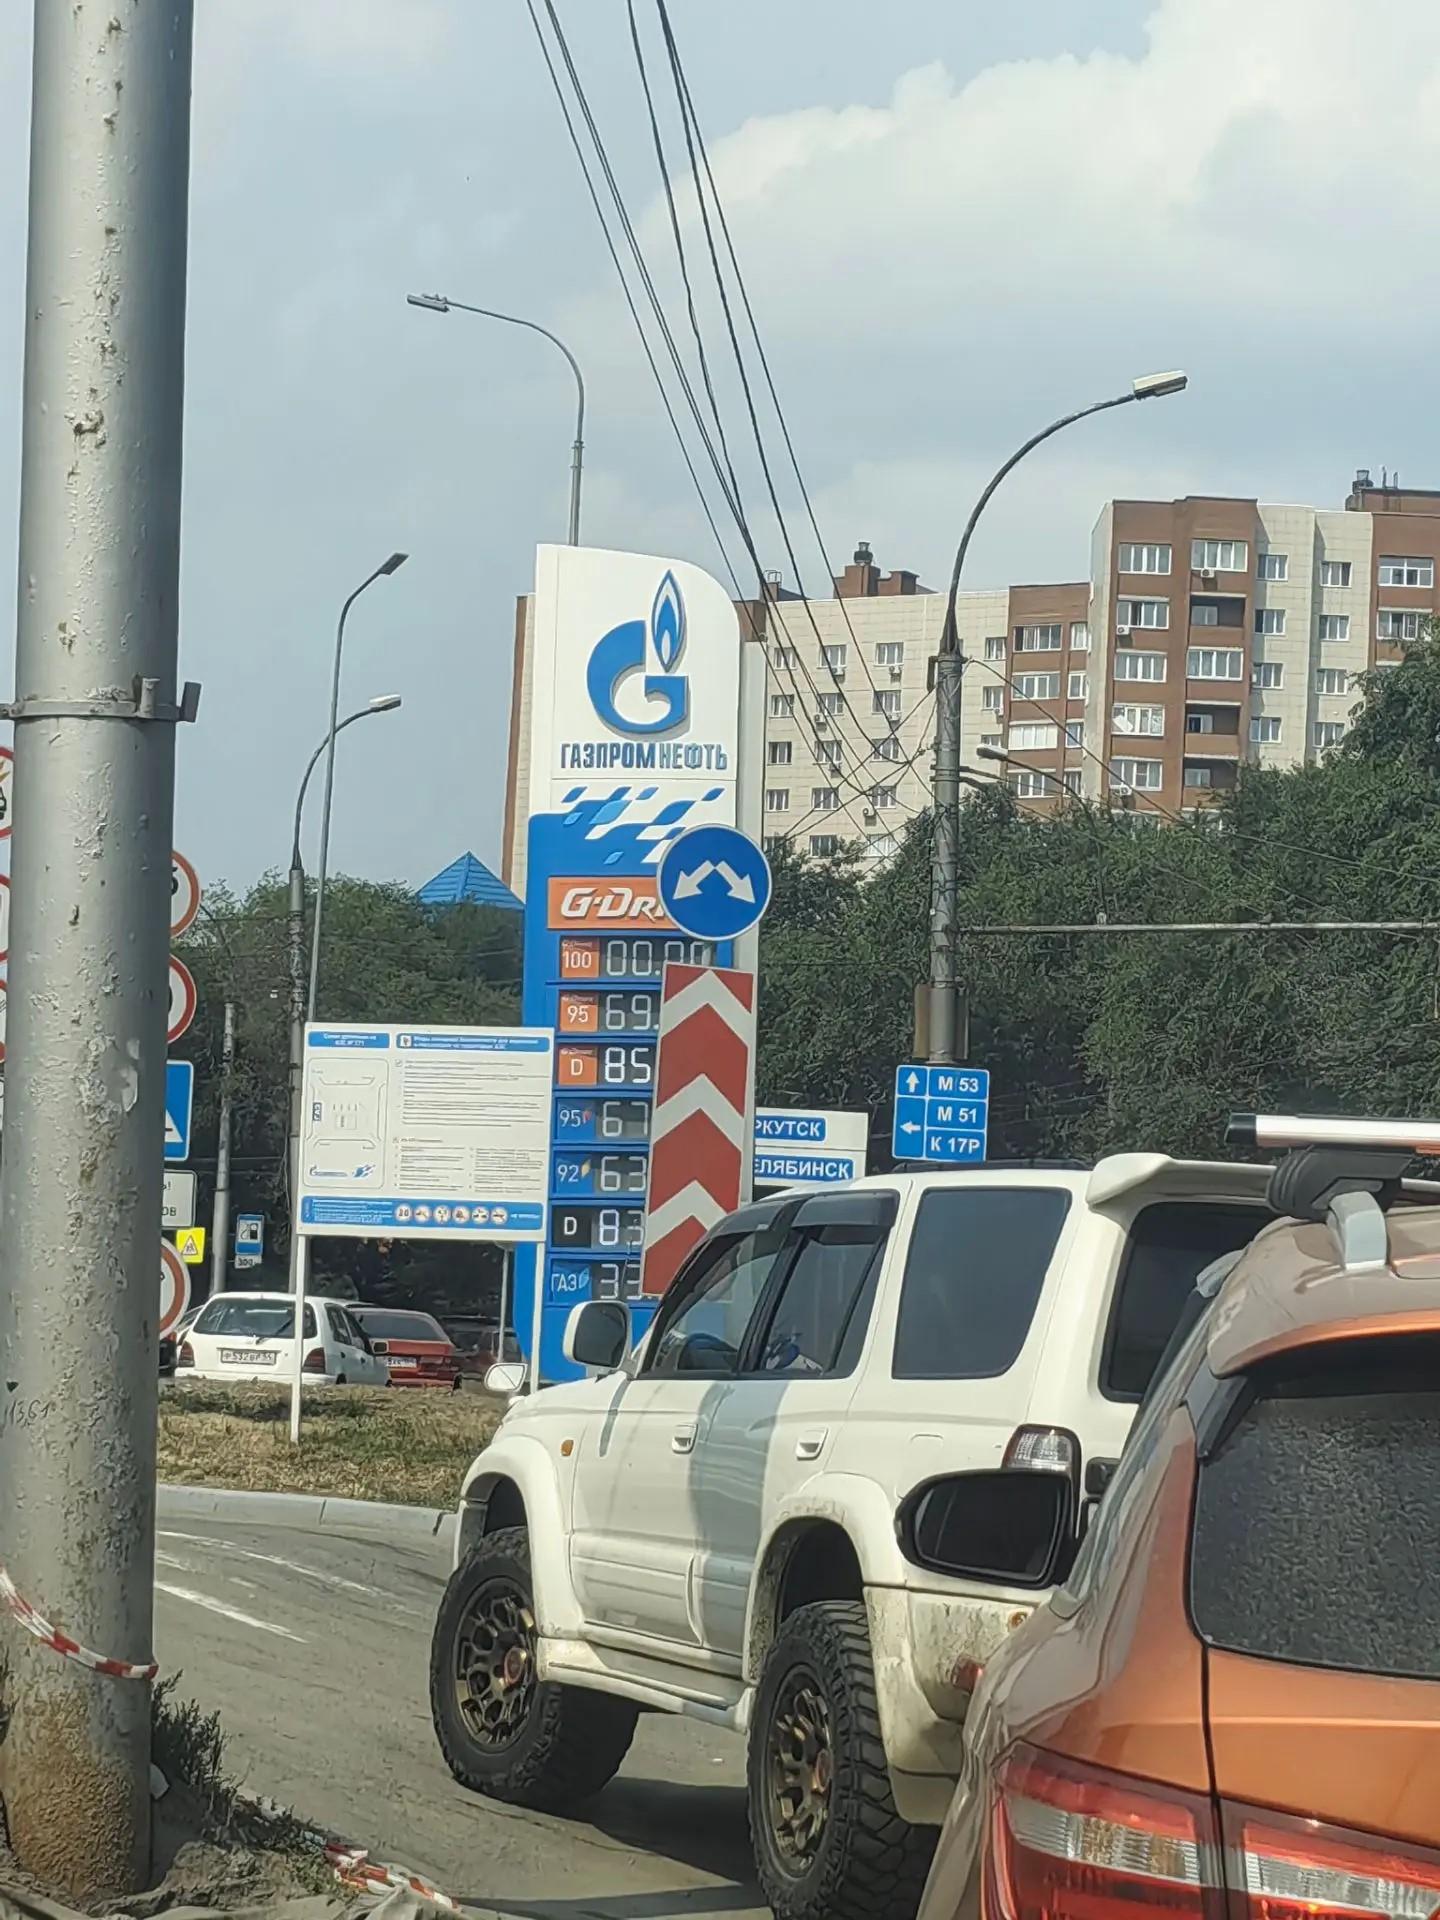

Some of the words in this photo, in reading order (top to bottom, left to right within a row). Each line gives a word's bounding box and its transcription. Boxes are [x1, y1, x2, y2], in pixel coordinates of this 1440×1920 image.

[560, 742, 728, 770] ГАЗПРОМНЕФТЬ
[563, 950, 592, 969] 100
[567, 1005, 589, 1024] 95
[570, 1058, 583, 1076] D
[604, 1047, 651, 1084] 85
[959, 1077, 979, 1093] 53
[559, 1109, 582, 1128] 95
[602, 1101, 649, 1137] 67
[959, 1107, 977, 1124] 51
[557, 1164, 579, 1183] 92
[600, 1155, 647, 1192] 63
[563, 1216, 577, 1235] D
[599, 1209, 645, 1246] 83
[551, 1272, 577, 1291] ГАЗ
